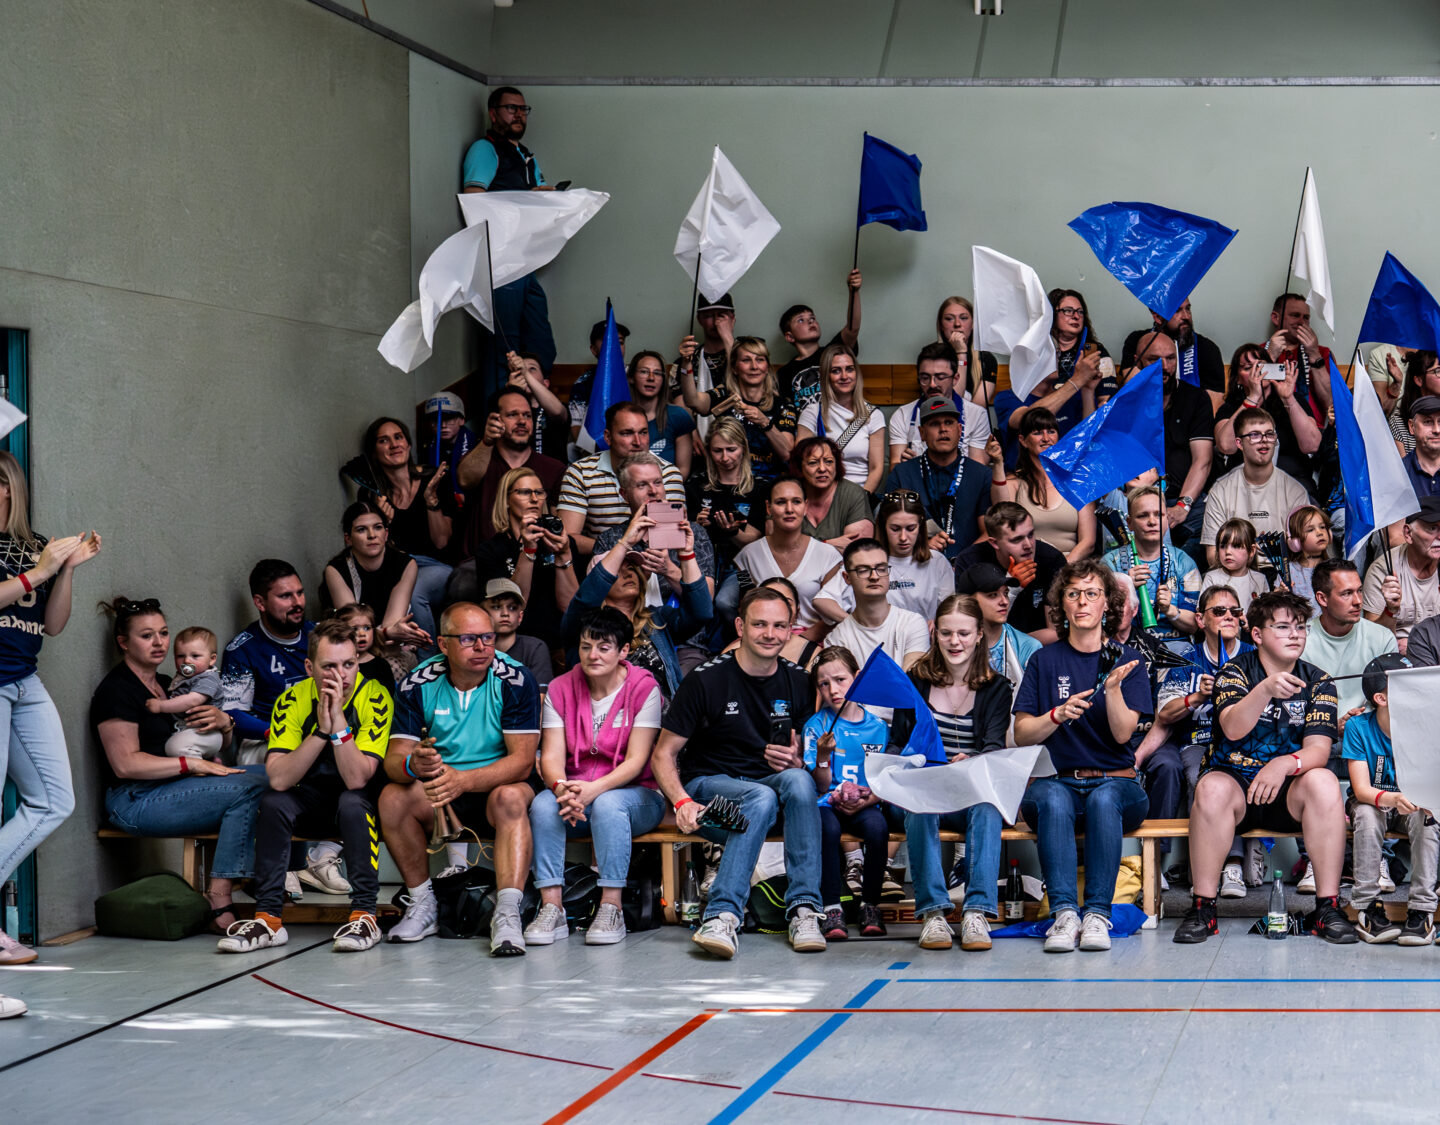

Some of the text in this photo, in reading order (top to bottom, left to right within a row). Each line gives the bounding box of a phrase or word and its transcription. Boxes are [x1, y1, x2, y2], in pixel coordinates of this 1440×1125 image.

[270, 654, 285, 676] 4
[1059, 686, 1070, 699] 15
[1305, 708, 1331, 722] eins
